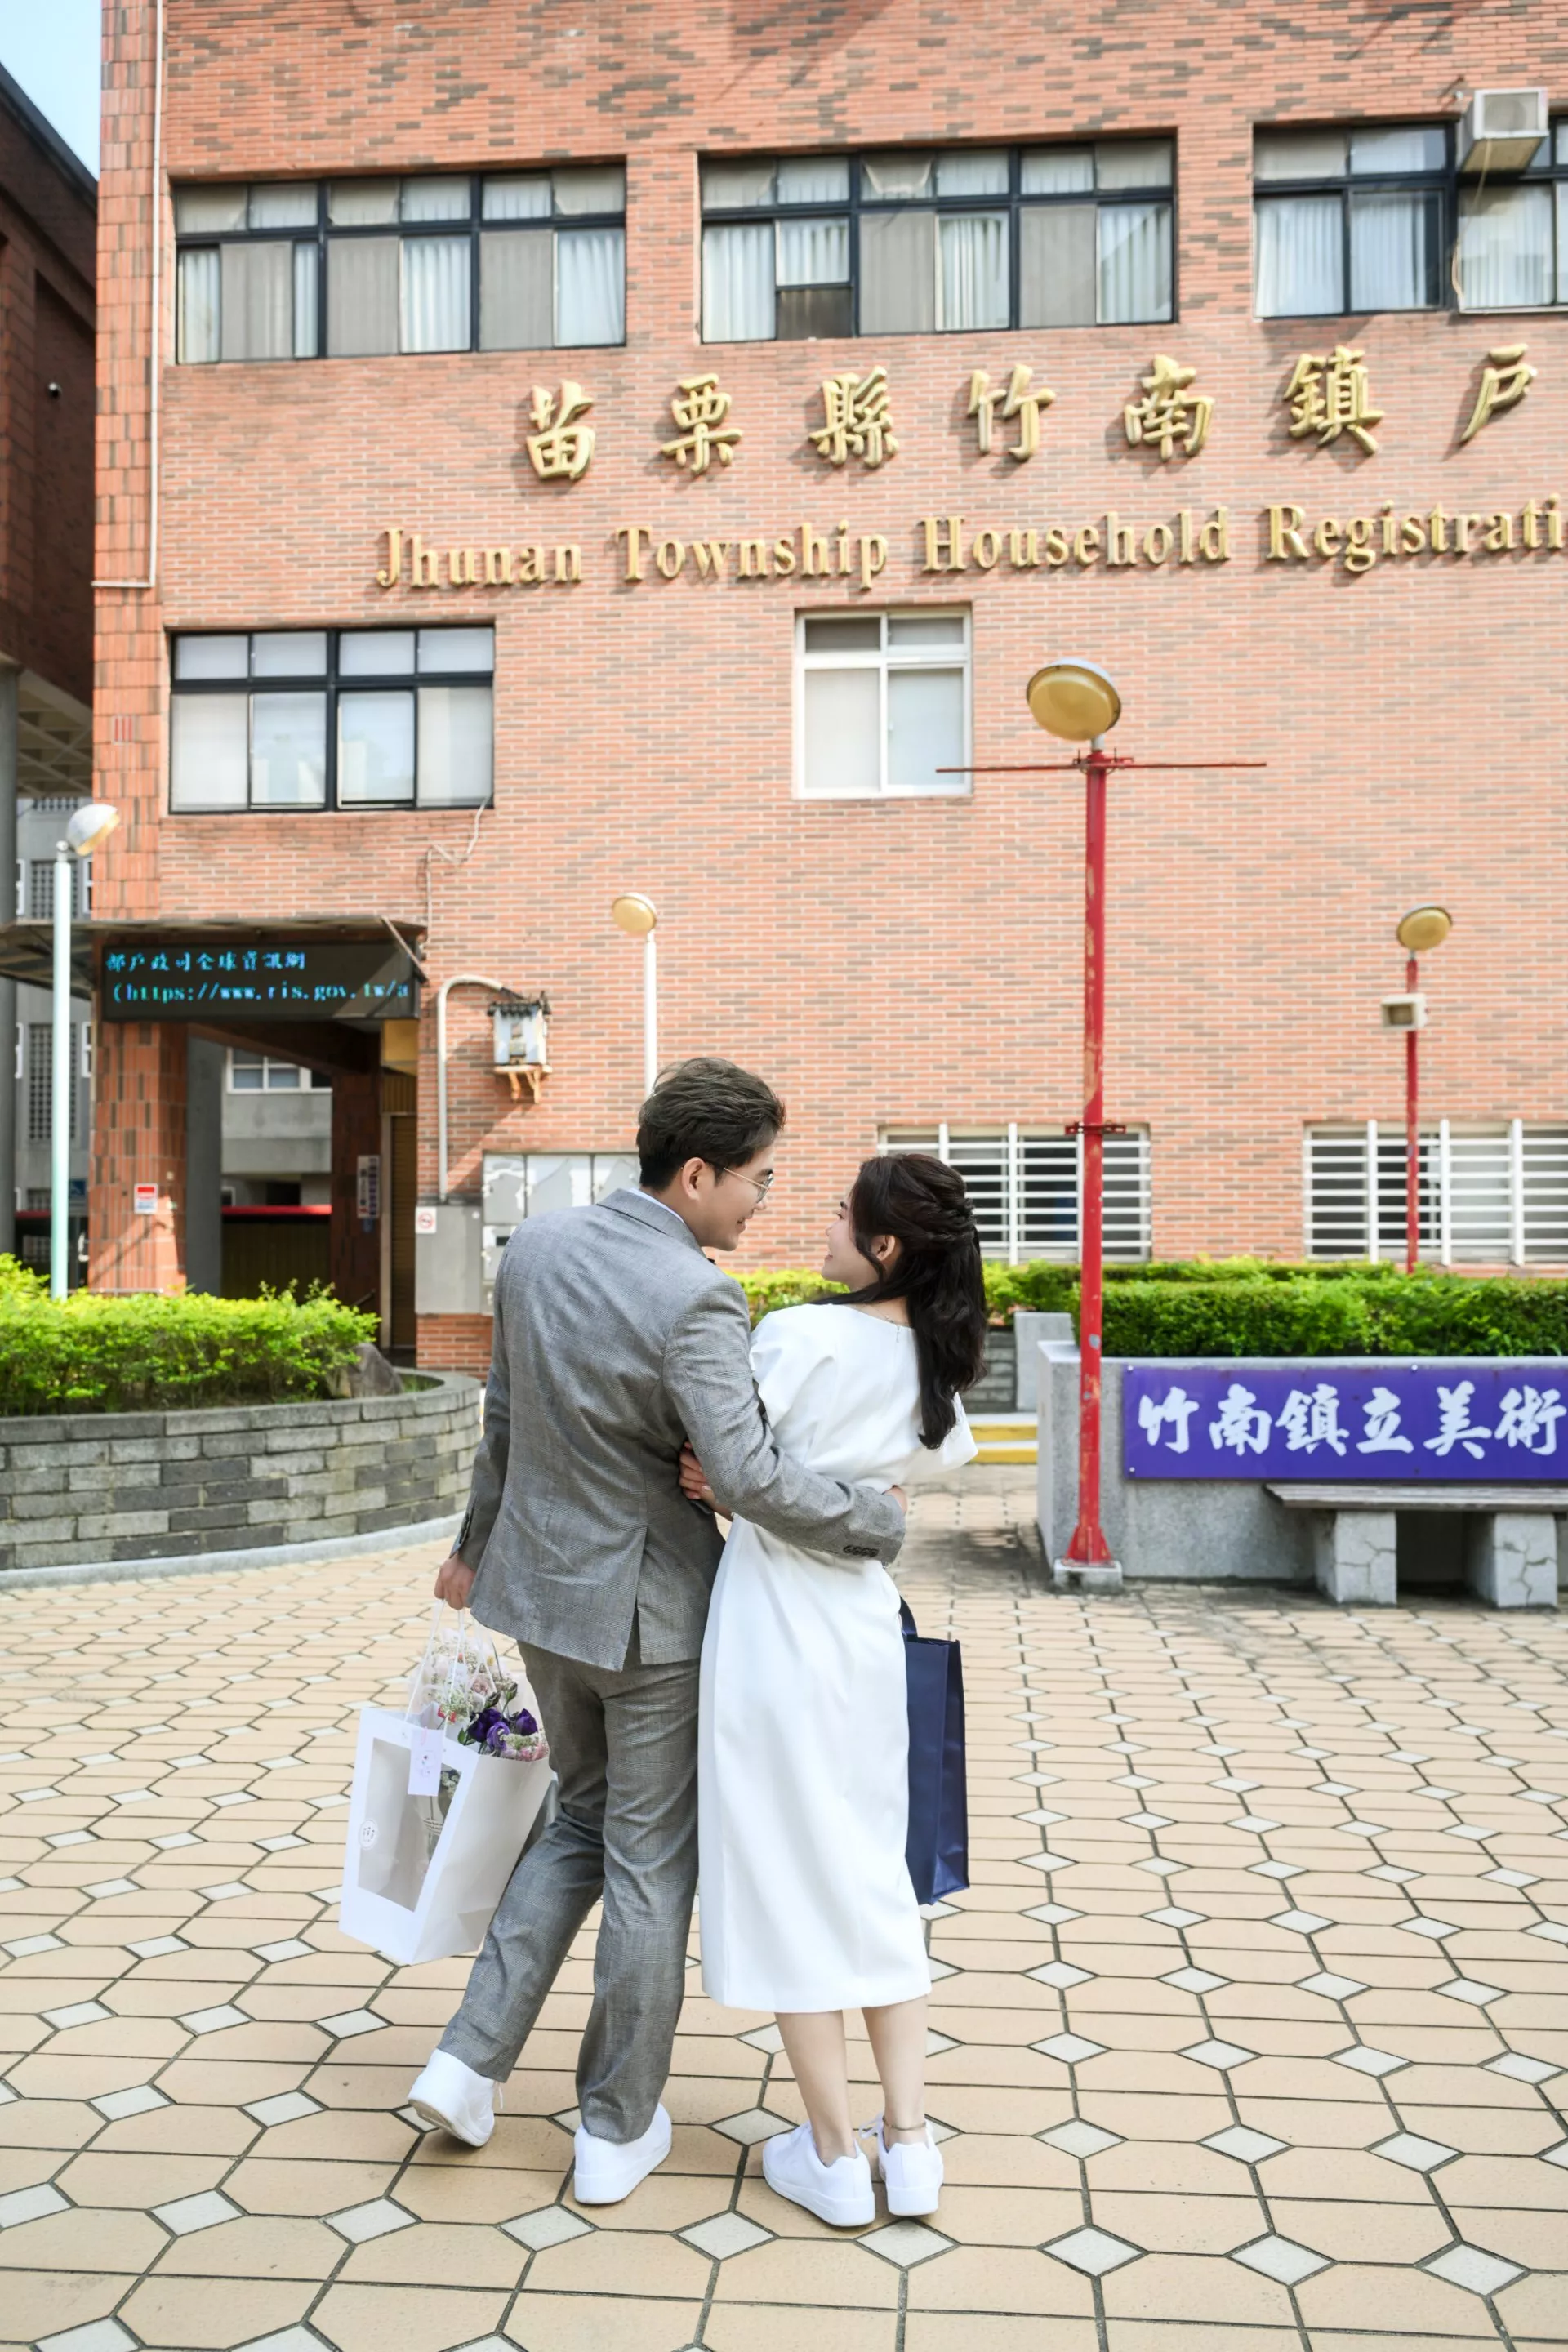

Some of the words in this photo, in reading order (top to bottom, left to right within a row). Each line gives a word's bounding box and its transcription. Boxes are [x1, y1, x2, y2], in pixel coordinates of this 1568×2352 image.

[376, 527, 583, 589] Jhunan
[616, 519, 889, 591] Township
[919, 505, 1232, 574] Household
[1266, 492, 1566, 574] Registrati
[1138, 1380, 1567, 1459] 竹南鎮立美術
